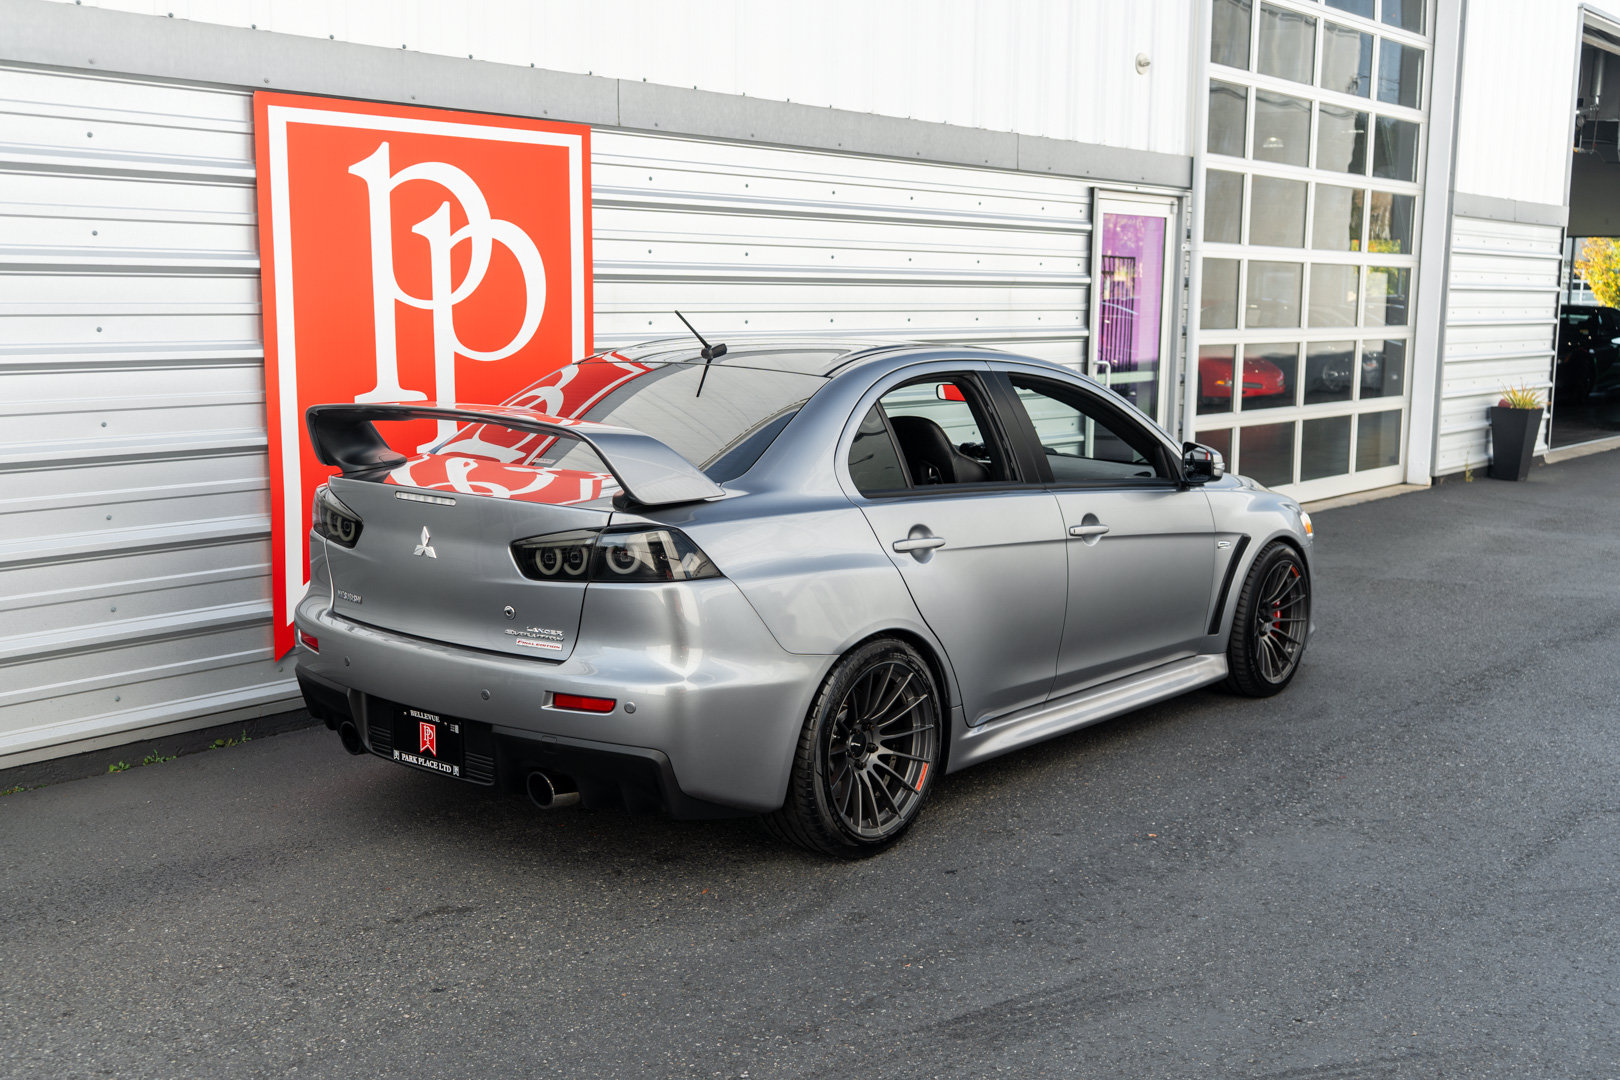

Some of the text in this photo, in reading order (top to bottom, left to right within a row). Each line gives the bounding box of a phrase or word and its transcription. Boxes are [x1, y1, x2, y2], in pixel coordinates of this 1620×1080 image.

[526, 626, 564, 636] LANCER
[410, 709, 440, 723] BELLEVUE
[401, 753, 452, 773] PARK PLACE LTD
